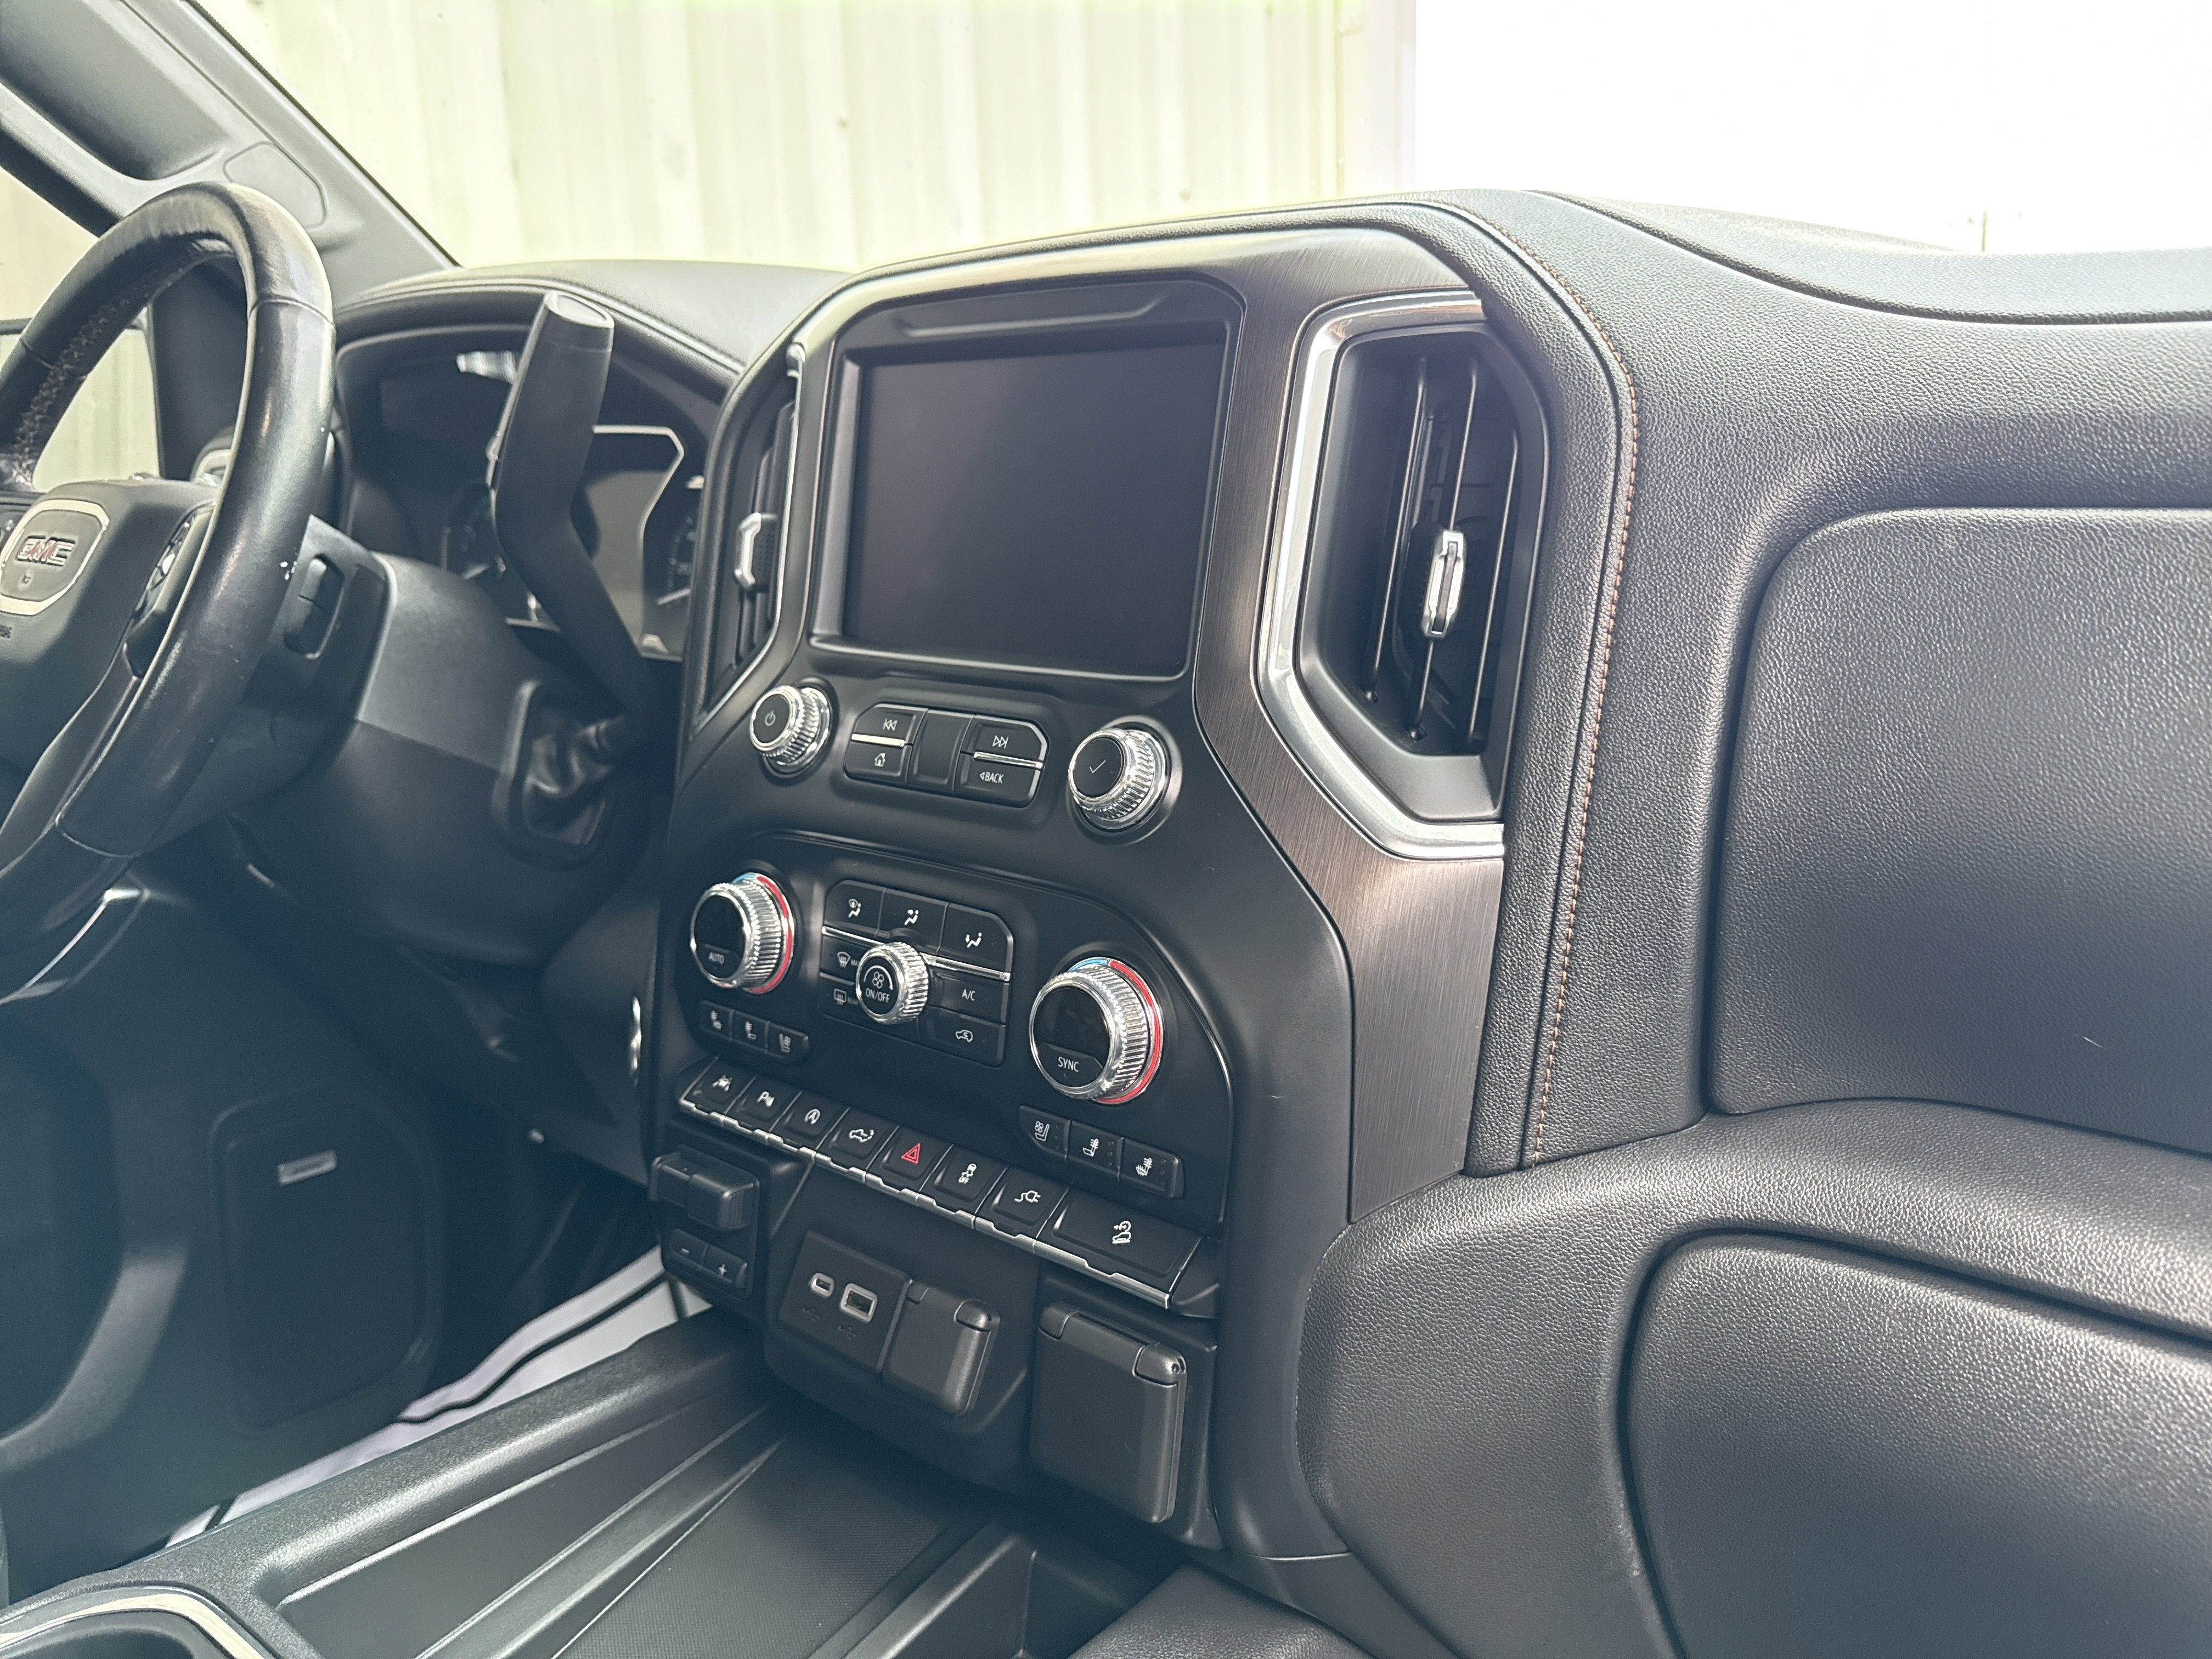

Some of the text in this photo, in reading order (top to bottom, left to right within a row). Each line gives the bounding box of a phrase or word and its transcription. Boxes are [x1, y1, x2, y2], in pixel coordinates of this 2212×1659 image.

[17, 535, 76, 566] GMC
[984, 771, 1004, 784] BACK
[709, 952, 725, 964] AUTO
[865, 988, 890, 1003] ON/OFF
[961, 989, 975, 1001] A/C
[1058, 1057, 1079, 1072] SYNC
